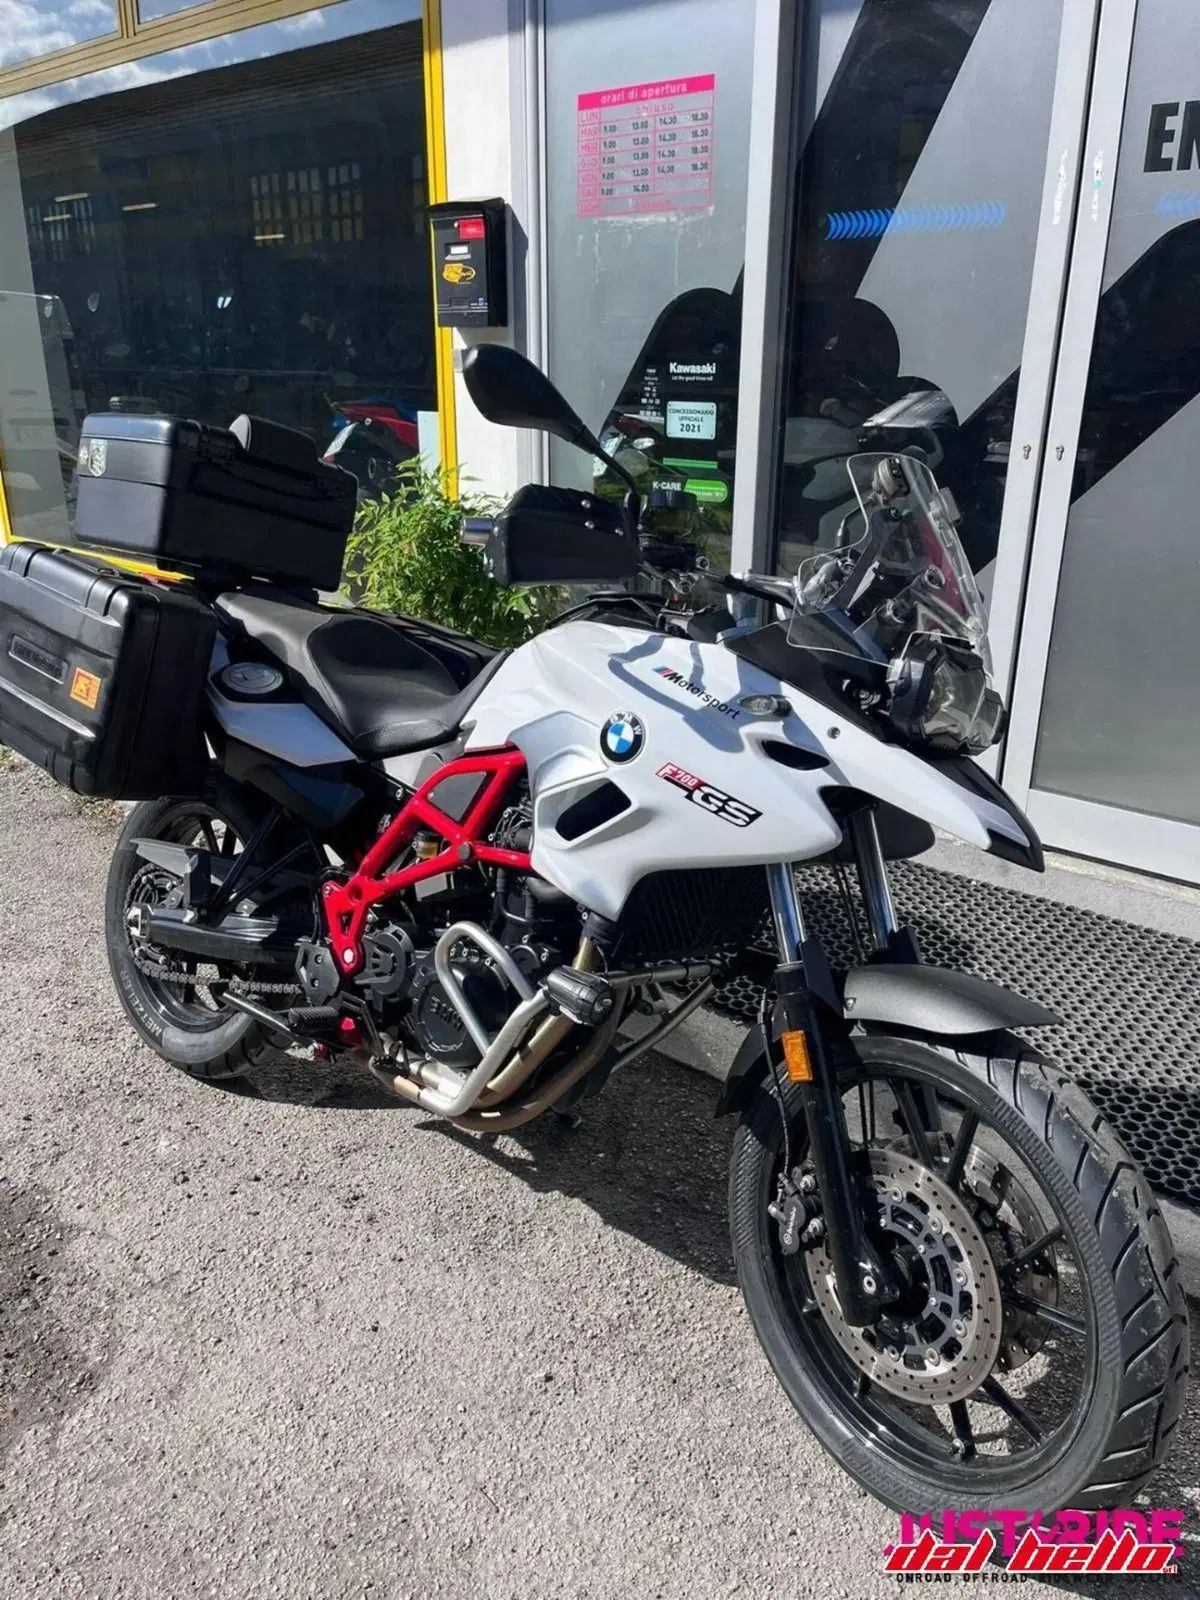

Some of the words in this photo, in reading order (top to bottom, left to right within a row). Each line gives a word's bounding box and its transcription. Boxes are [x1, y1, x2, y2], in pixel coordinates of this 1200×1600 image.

[601, 92, 625, 104] orari
[628, 88, 639, 100] di
[642, 83, 688, 97] apertura
[669, 362, 716, 374] Kawasaki
[668, 408, 715, 416] CONCESSIONARIO
[680, 424, 701, 433] 2021
[666, 670, 741, 720] Motorsport
[691, 785, 759, 827] GS
[120, 970, 162, 1037] METZELER
